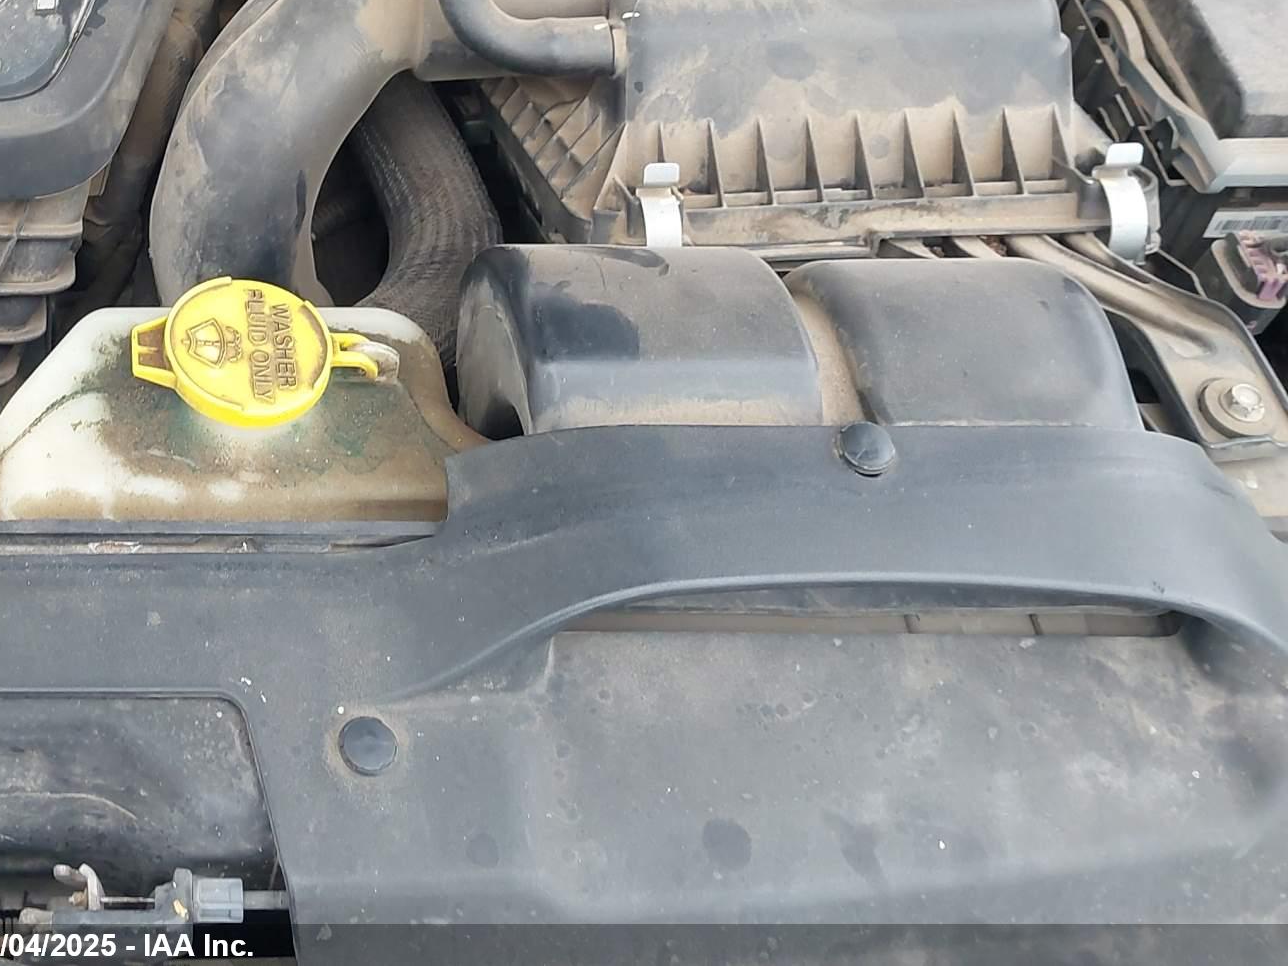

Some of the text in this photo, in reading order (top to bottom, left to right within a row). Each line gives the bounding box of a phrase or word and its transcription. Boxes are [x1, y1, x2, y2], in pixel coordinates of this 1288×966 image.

[244, 287, 276, 405] FLUID ONLY
[270, 302, 299, 390] WASHER
